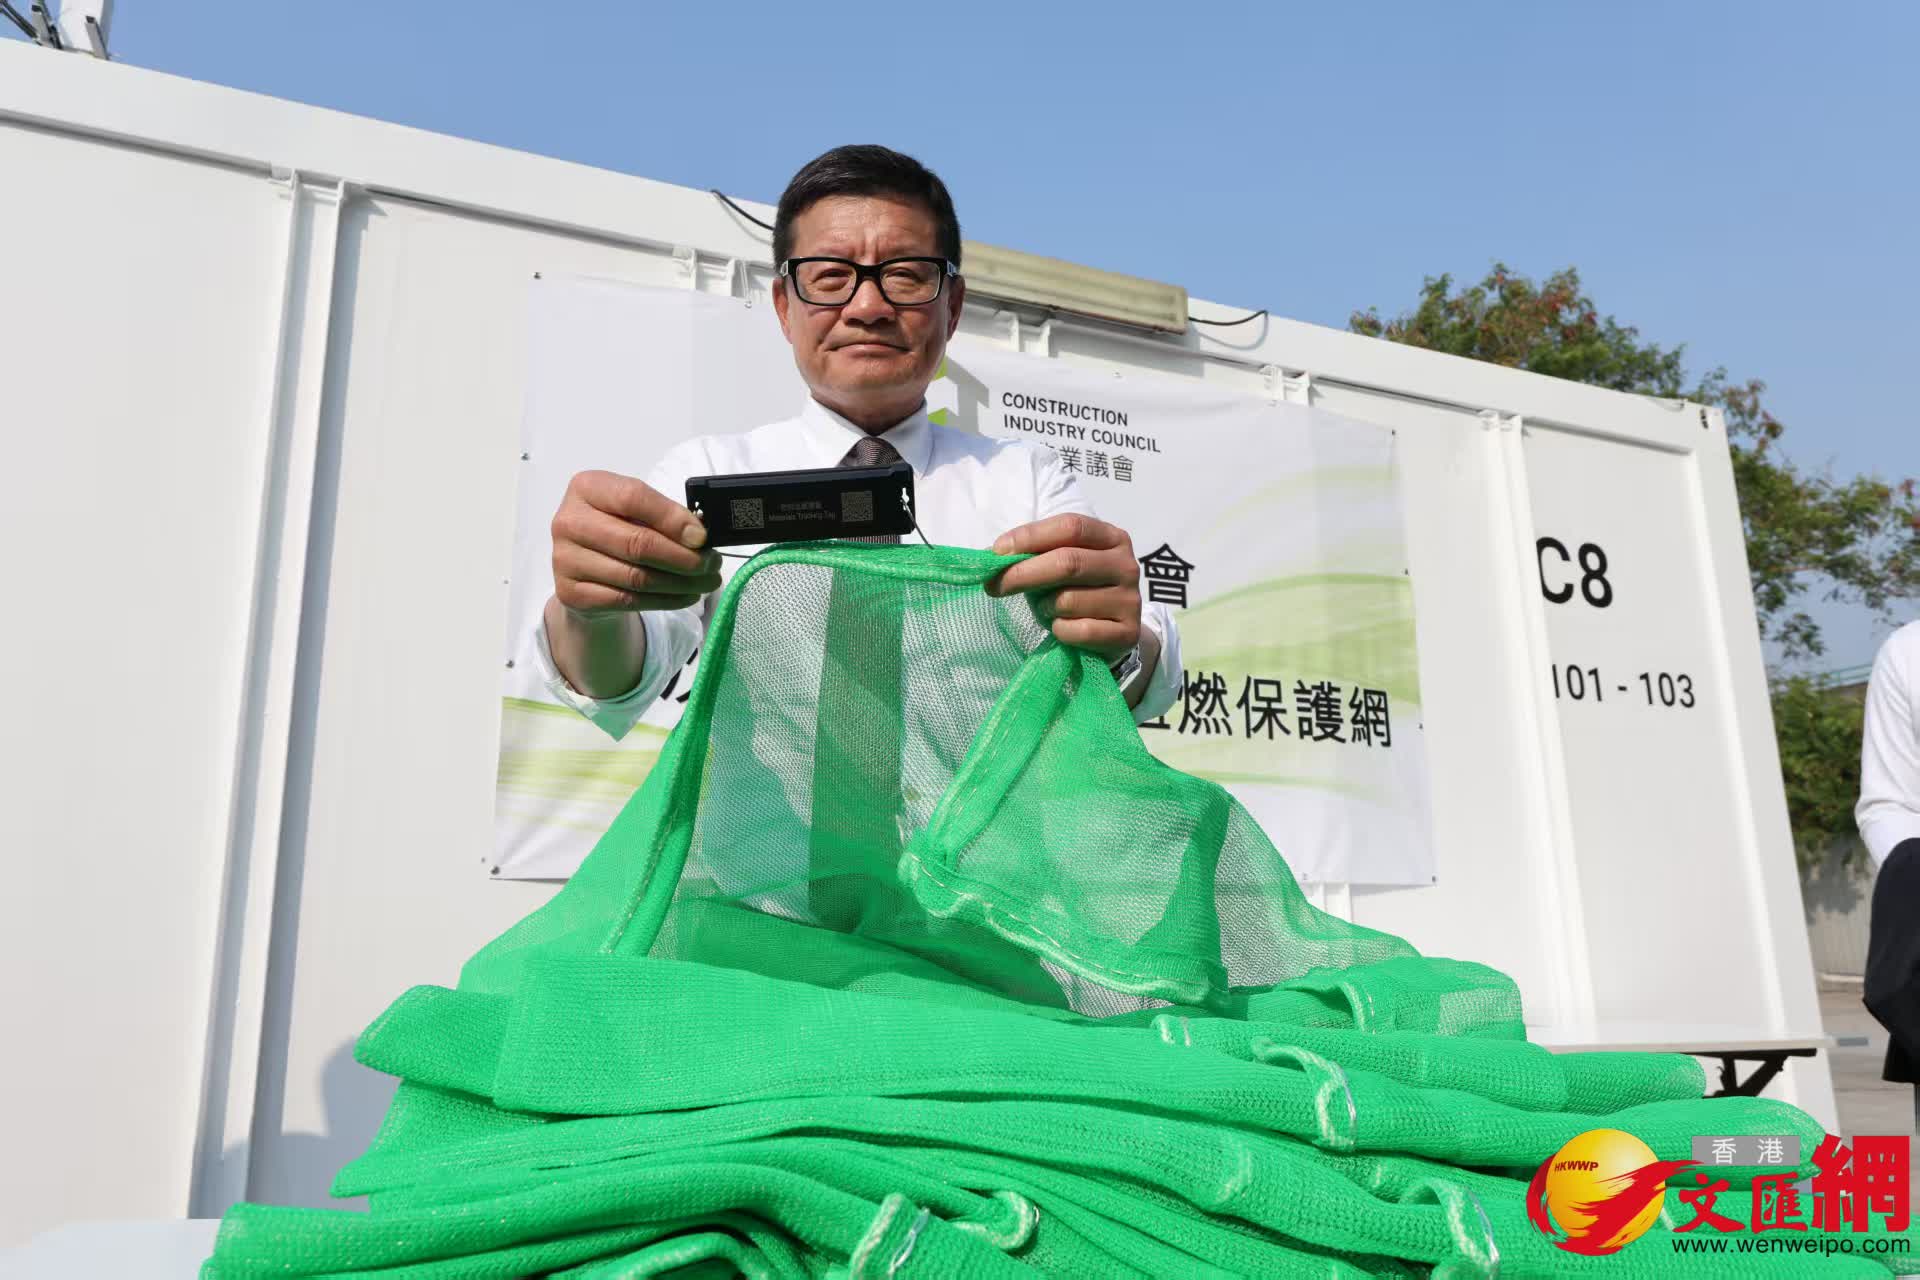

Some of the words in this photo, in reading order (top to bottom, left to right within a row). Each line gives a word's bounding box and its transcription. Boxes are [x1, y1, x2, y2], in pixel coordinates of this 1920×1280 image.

[1002, 391, 1128, 427] CONSTRUCTION
[1003, 414, 1087, 441] INDUSTRY
[1091, 428, 1161, 453] COUNCIL
[1039, 440, 1134, 482] 業議會
[1138, 543, 1195, 609] 會
[1536, 537, 1613, 607] C8
[1138, 669, 1391, 748] 燃保護網
[1639, 672, 1695, 709] 103
